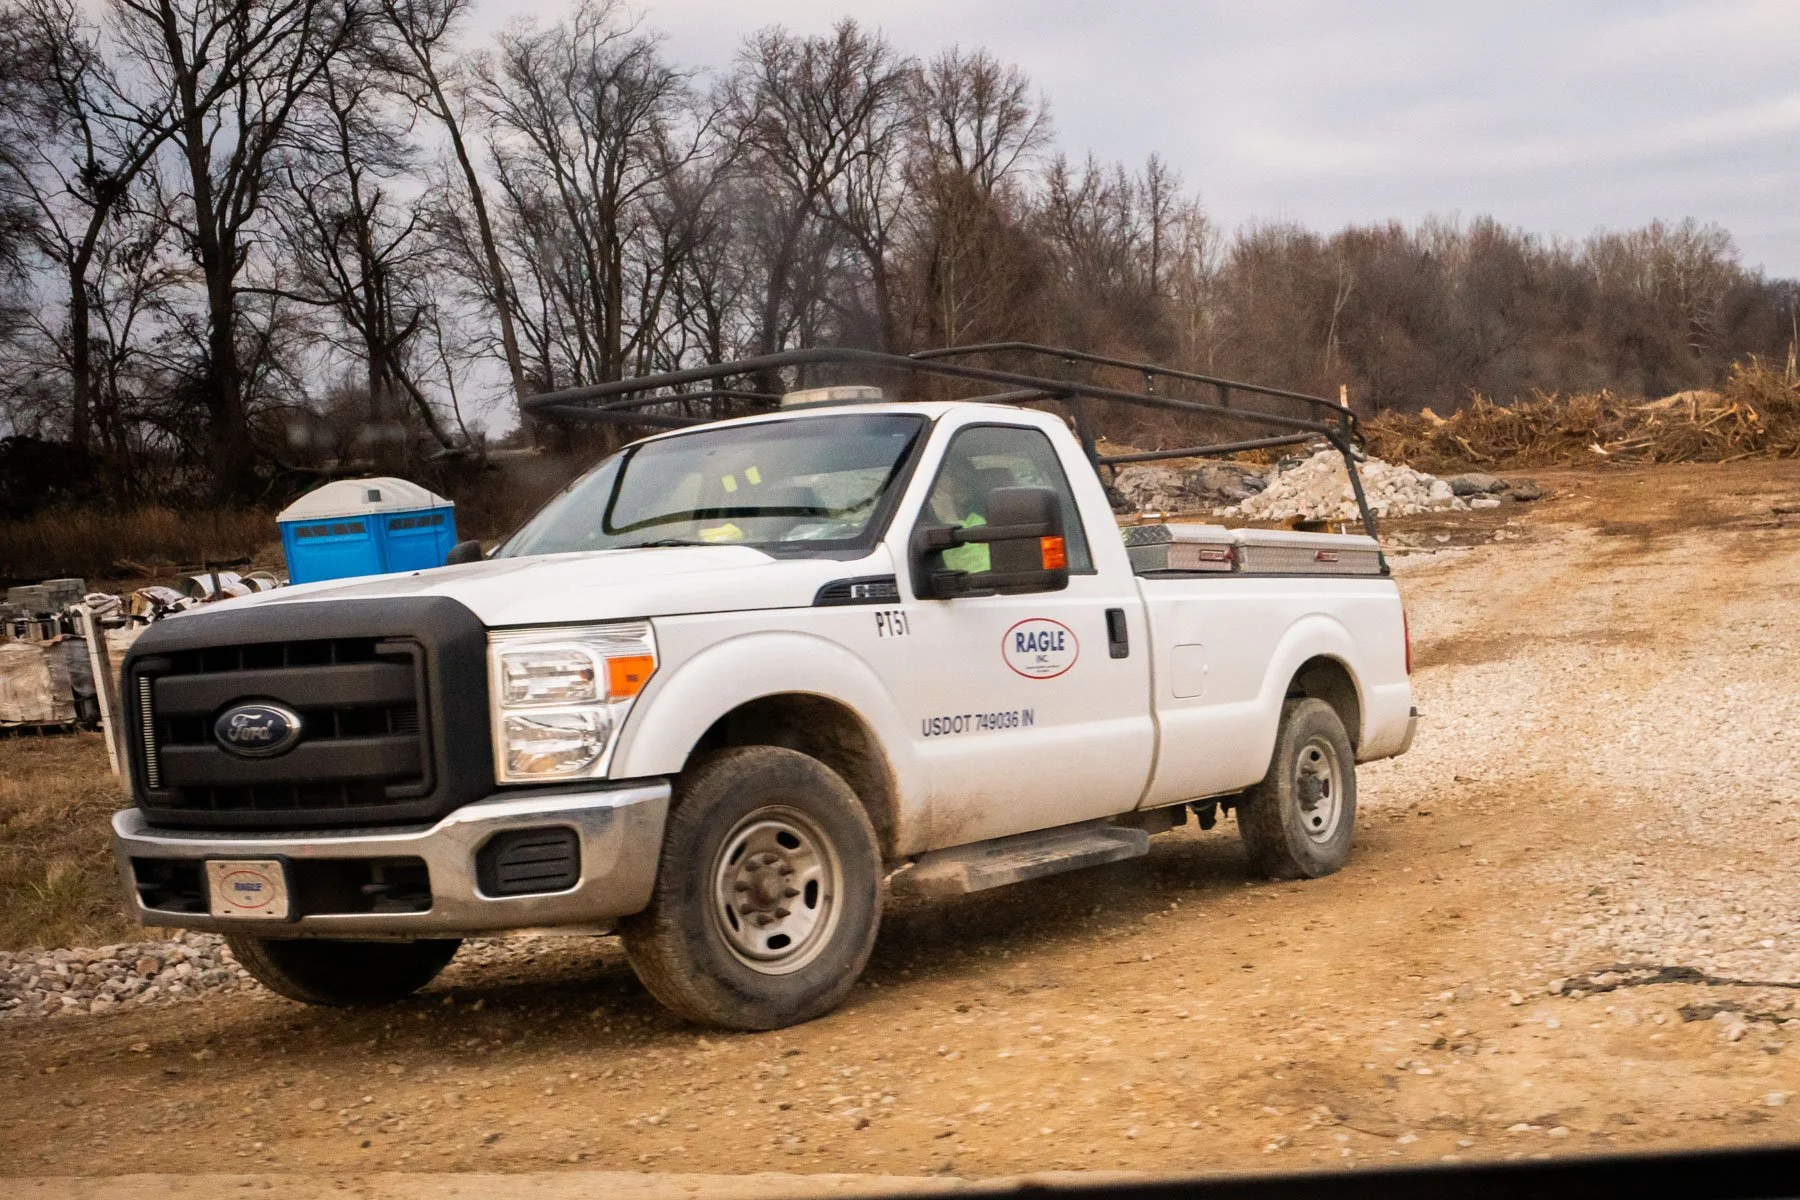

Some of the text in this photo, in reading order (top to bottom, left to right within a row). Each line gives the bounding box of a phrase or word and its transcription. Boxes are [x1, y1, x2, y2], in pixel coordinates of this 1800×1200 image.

[875, 610, 911, 637] PT51
[1015, 630, 1065, 653] RAGLE
[227, 713, 274, 742] Ford
[922, 708, 1034, 737] USDOT 749036 IN
